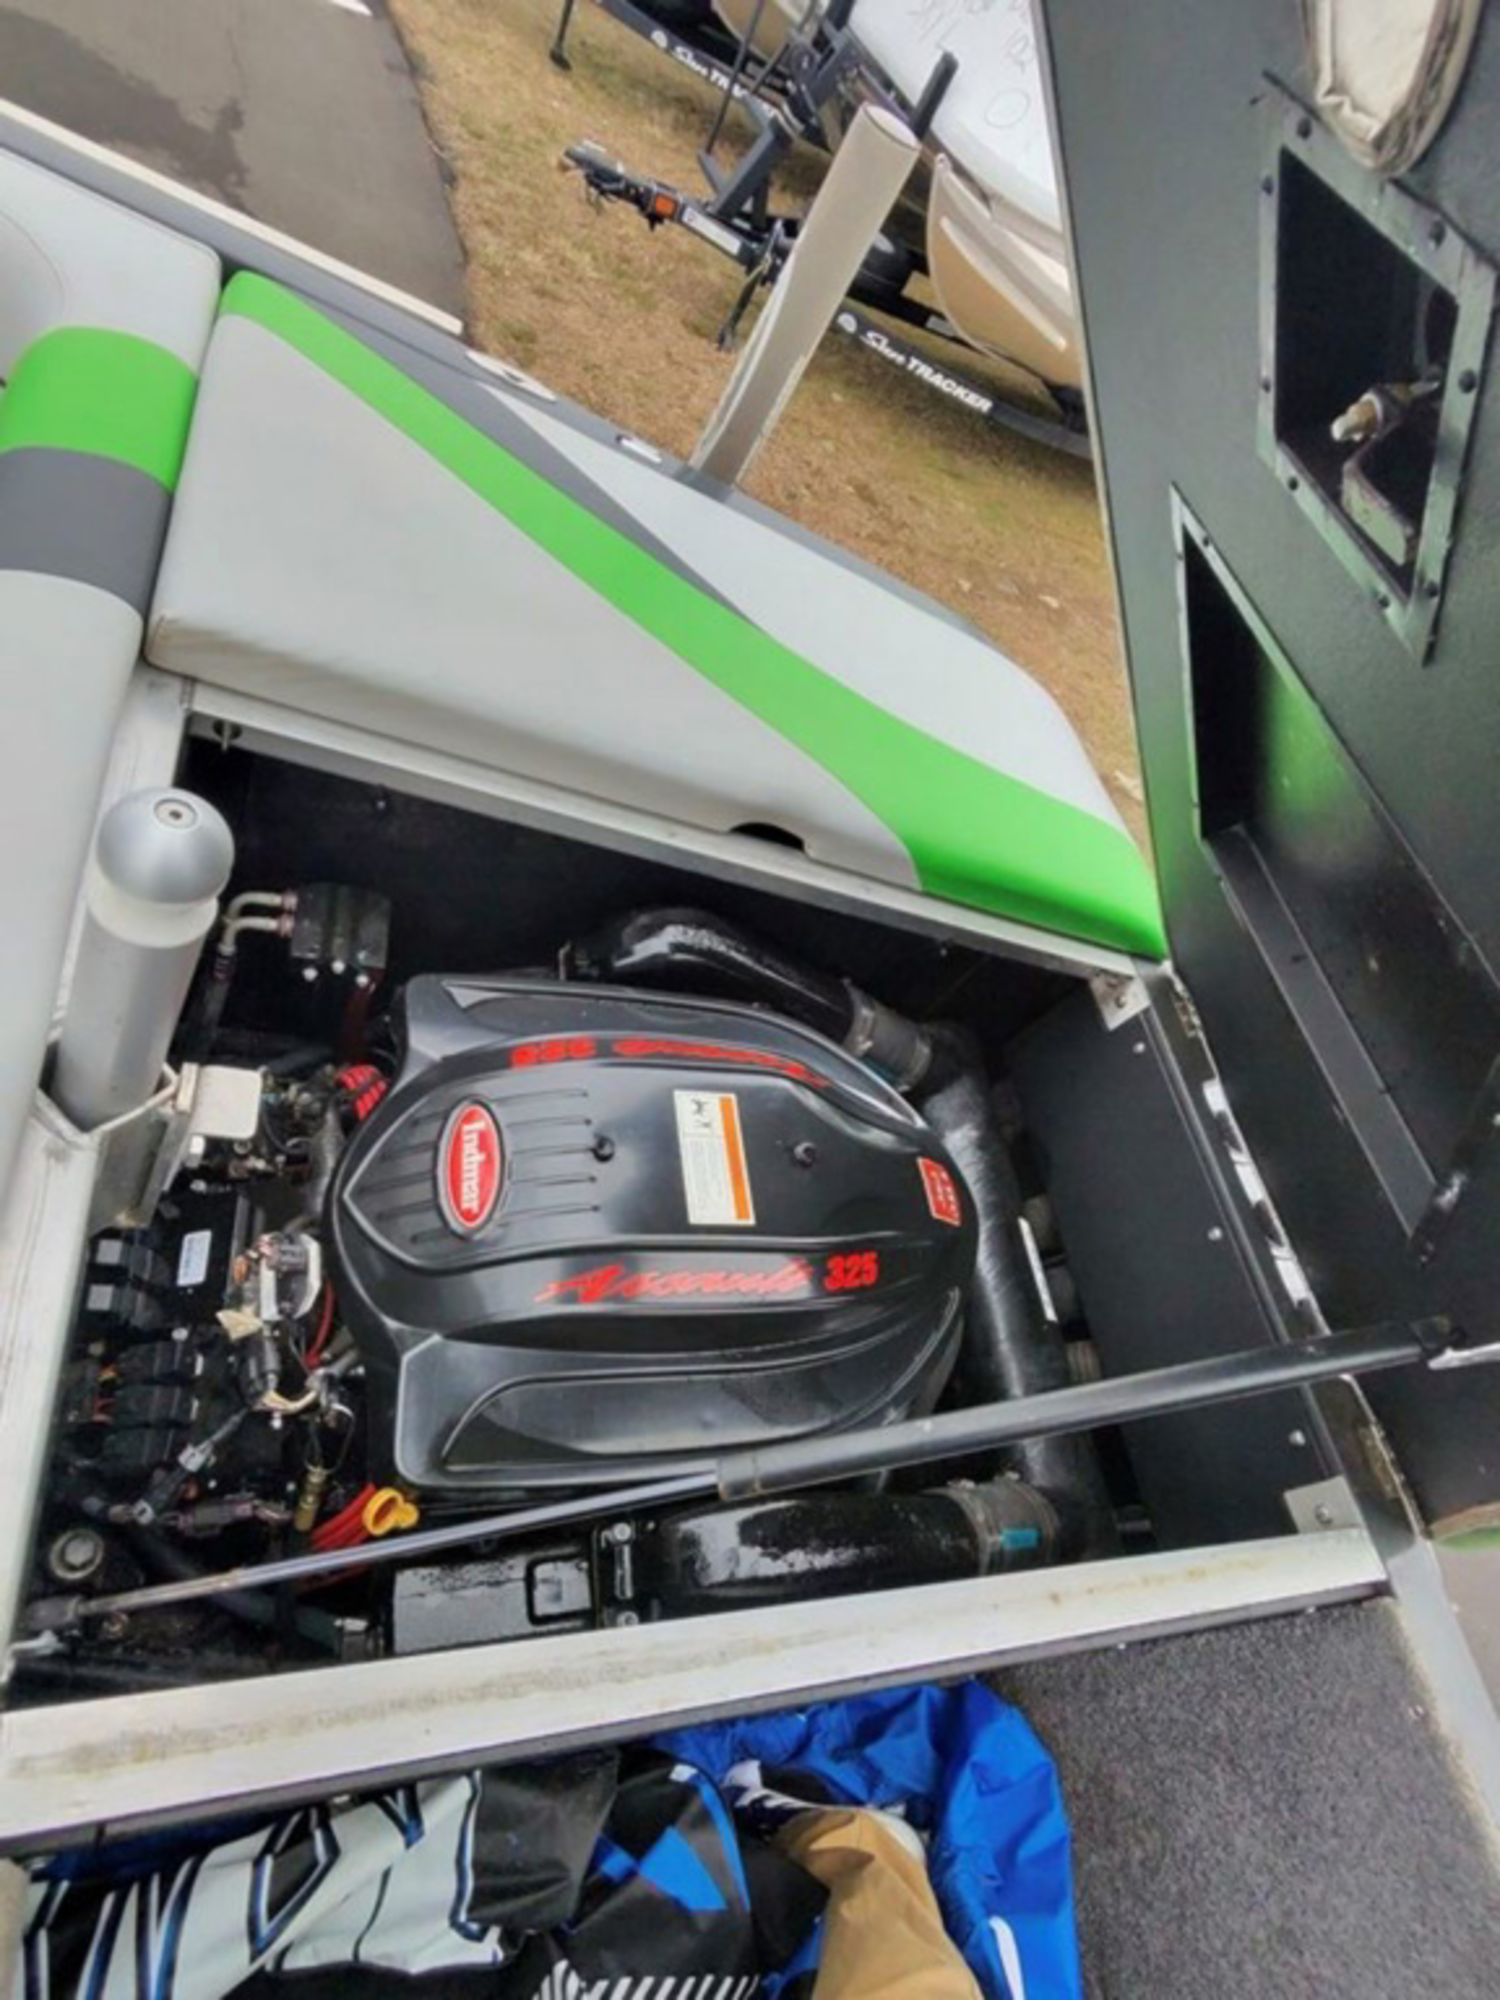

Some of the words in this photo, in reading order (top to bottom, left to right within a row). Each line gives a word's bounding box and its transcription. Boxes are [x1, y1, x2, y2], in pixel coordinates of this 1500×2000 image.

[906, 356, 993, 414] TRACKER
[462, 1120, 486, 1214] Indmar
[823, 1251, 878, 1291] 325
